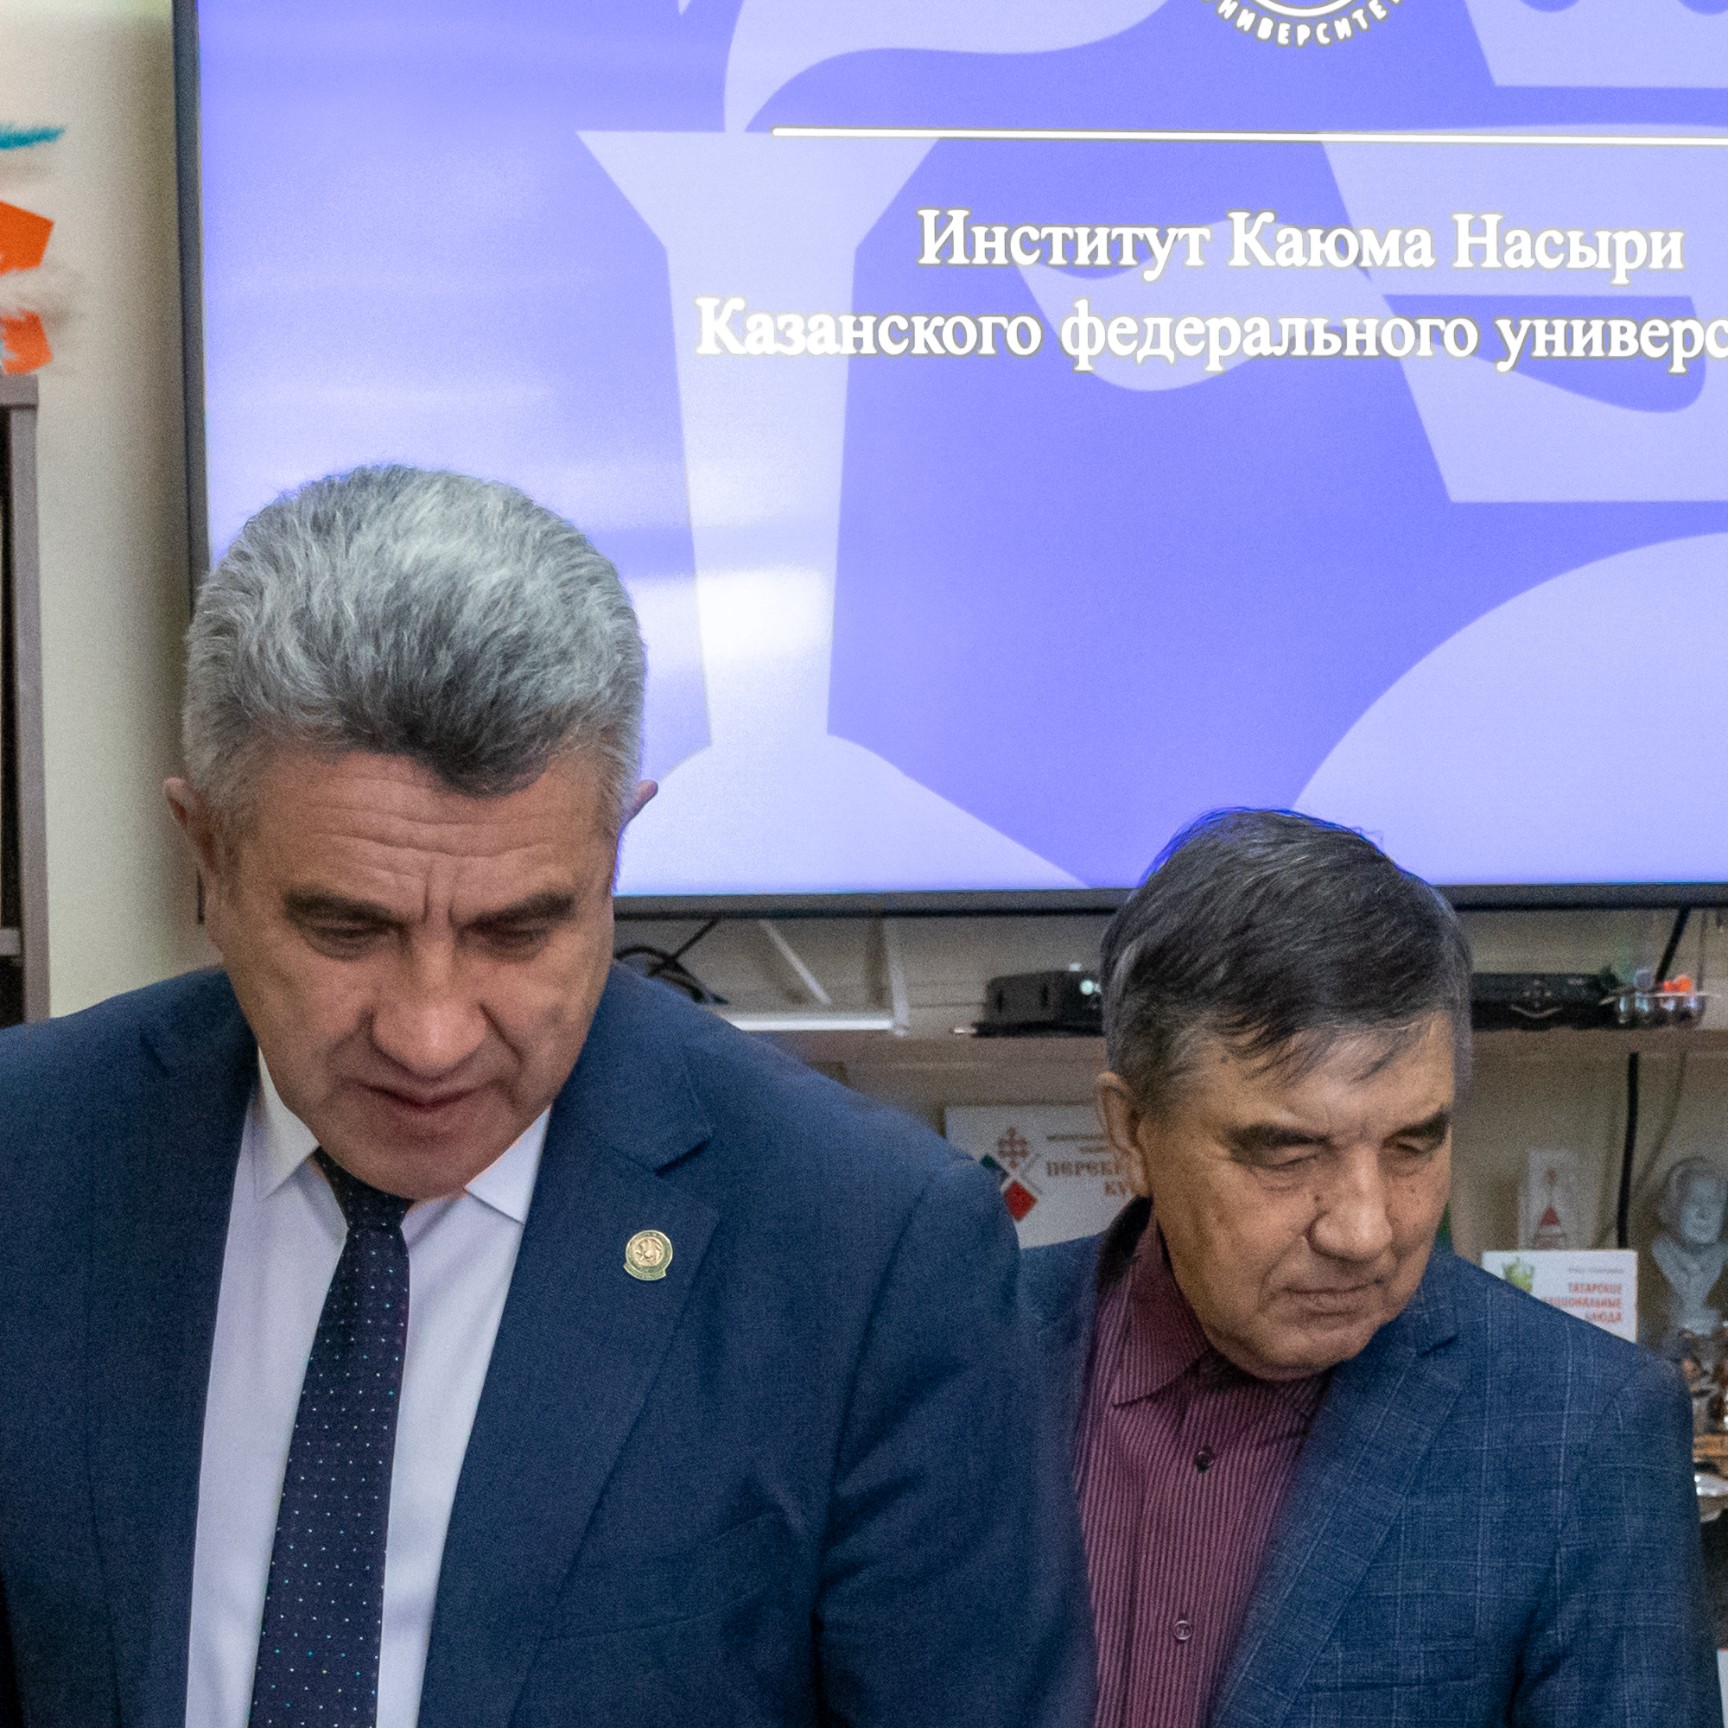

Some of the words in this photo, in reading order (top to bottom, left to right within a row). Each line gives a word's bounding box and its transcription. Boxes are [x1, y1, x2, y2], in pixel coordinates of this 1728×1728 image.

[916, 208, 1211, 282] Институт
[1227, 210, 1436, 269] Каюма
[1451, 213, 1685, 285] Насыри
[695, 296, 1043, 357] Казанского
[1060, 297, 1479, 373] федерального
